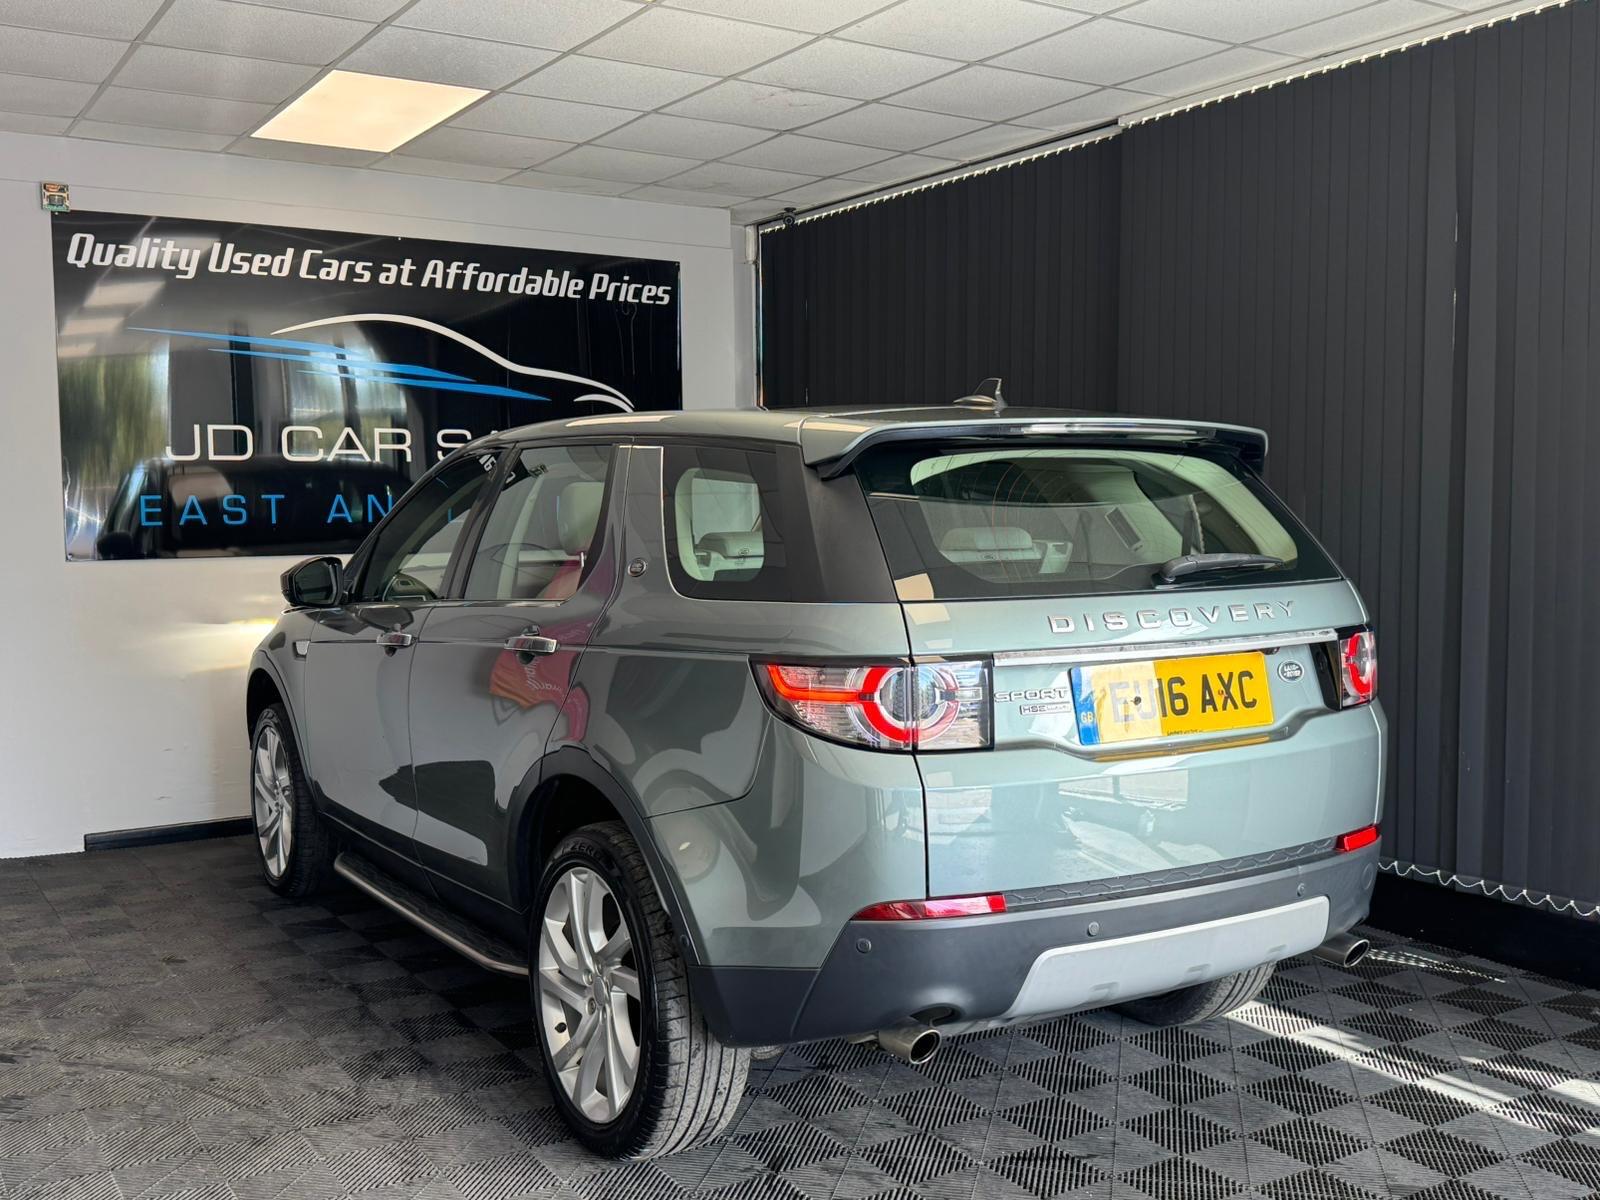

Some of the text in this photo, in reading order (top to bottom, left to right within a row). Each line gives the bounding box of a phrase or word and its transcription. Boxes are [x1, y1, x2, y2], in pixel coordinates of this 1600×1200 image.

[67, 233, 671, 305] Quality Used Cars at Affordable Prices
[166, 424, 254, 462] JD
[282, 426, 412, 462] CAR
[140, 494, 394, 526] EAST AN
[1047, 600, 1293, 633] DISCOVERY
[994, 686, 1067, 702] SPORT
[1109, 670, 1258, 723] EU16 AXC
[1081, 711, 1094, 723] GB
